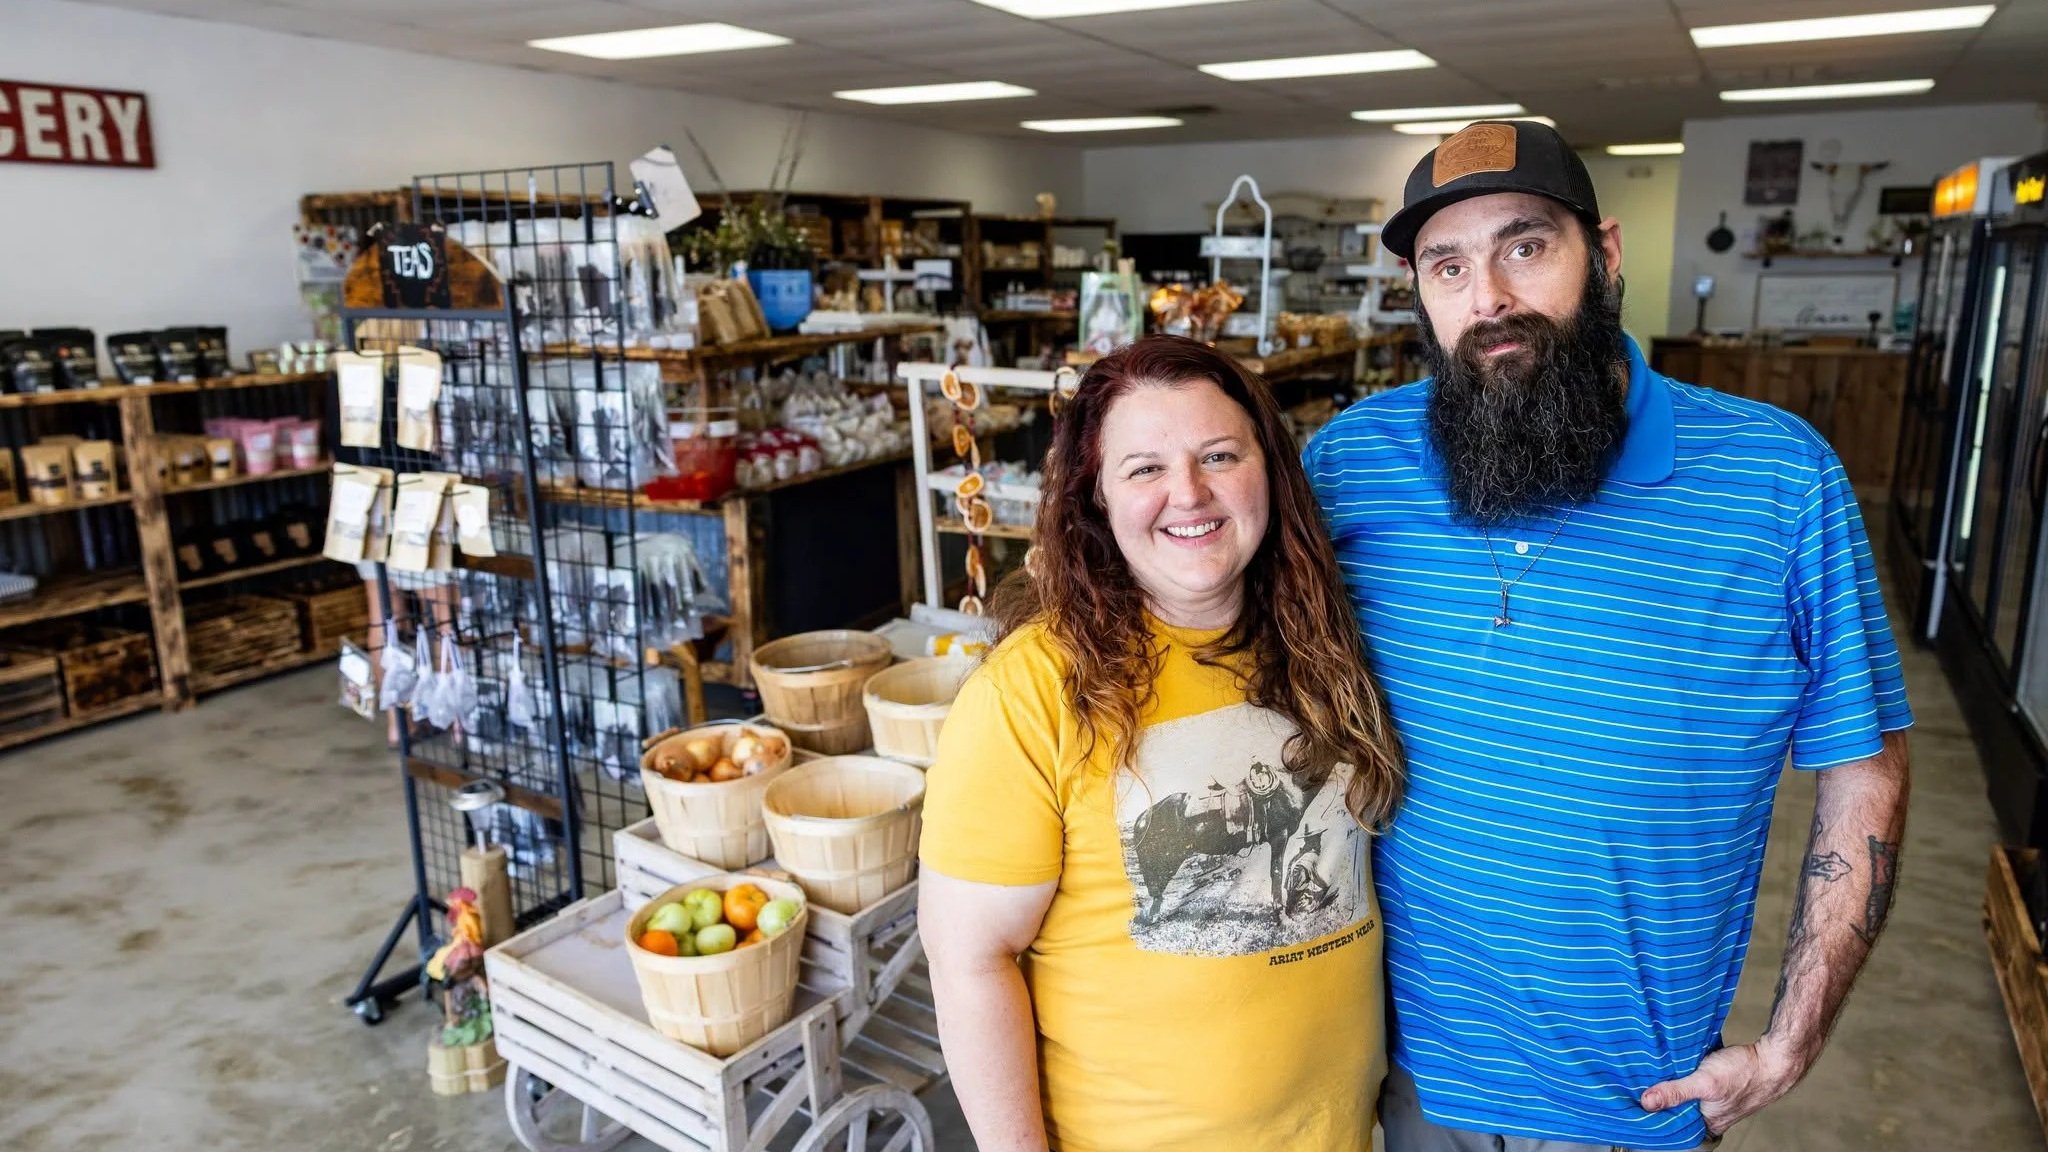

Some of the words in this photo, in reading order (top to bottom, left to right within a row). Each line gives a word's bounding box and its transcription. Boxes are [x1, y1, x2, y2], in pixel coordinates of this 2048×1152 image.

[387, 242, 433, 280] TEAS
[1269, 950, 1304, 966] ARIAT
[1307, 933, 1354, 958] WESTERN
[1356, 919, 1375, 939] WEAR
